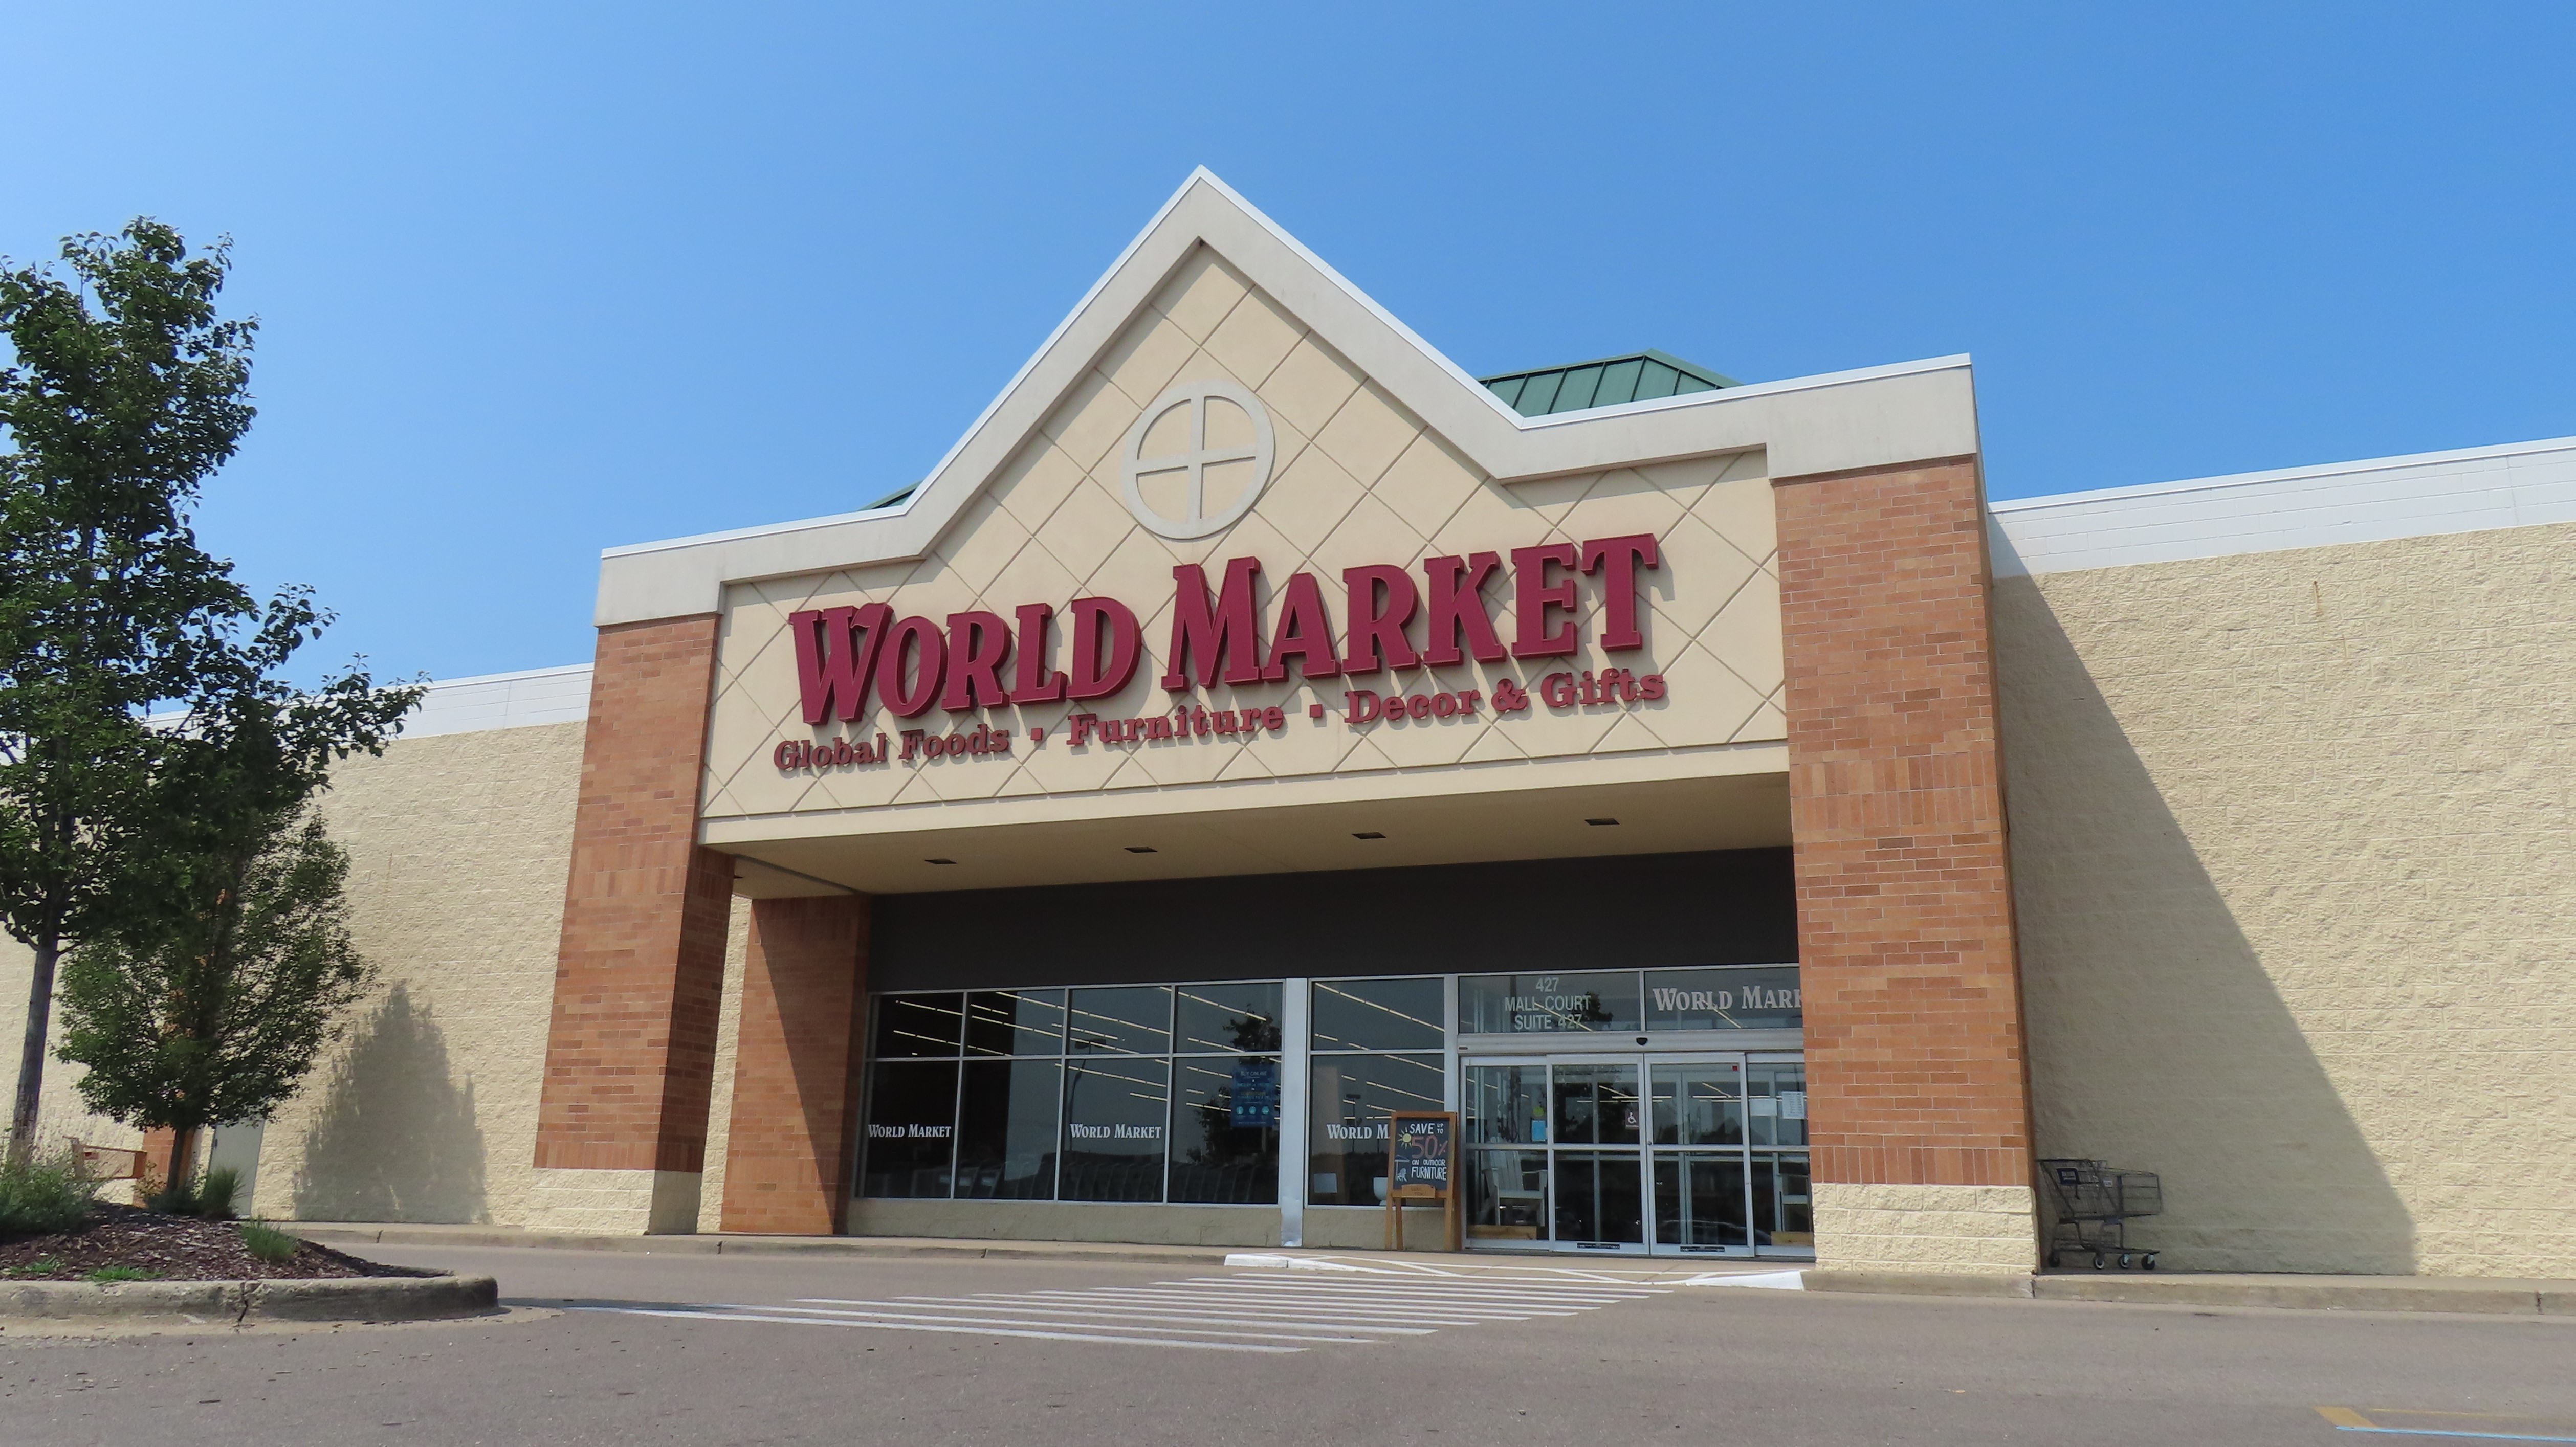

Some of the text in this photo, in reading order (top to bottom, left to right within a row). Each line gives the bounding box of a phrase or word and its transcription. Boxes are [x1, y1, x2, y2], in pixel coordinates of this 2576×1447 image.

[788, 532, 1659, 726] WORLD MARKET
[774, 668, 1665, 771] Global Foods Furniture Decor & Gifts
[1535, 977, 1559, 992] 427
[1505, 995, 1591, 1011] MALL COURT
[1653, 988, 1733, 1011] WORLD
[1514, 1014, 1583, 1030] SUITE 427
[868, 1123, 952, 1138] WORLD MARKET
[1070, 1123, 1162, 1139] WORLD MARKET
[1326, 1124, 1372, 1140] WORLD
[1409, 1123, 1435, 1134] SAVE
[1412, 1135, 1448, 1159] 50%
[1411, 1166, 1447, 1181] FURNITURE
